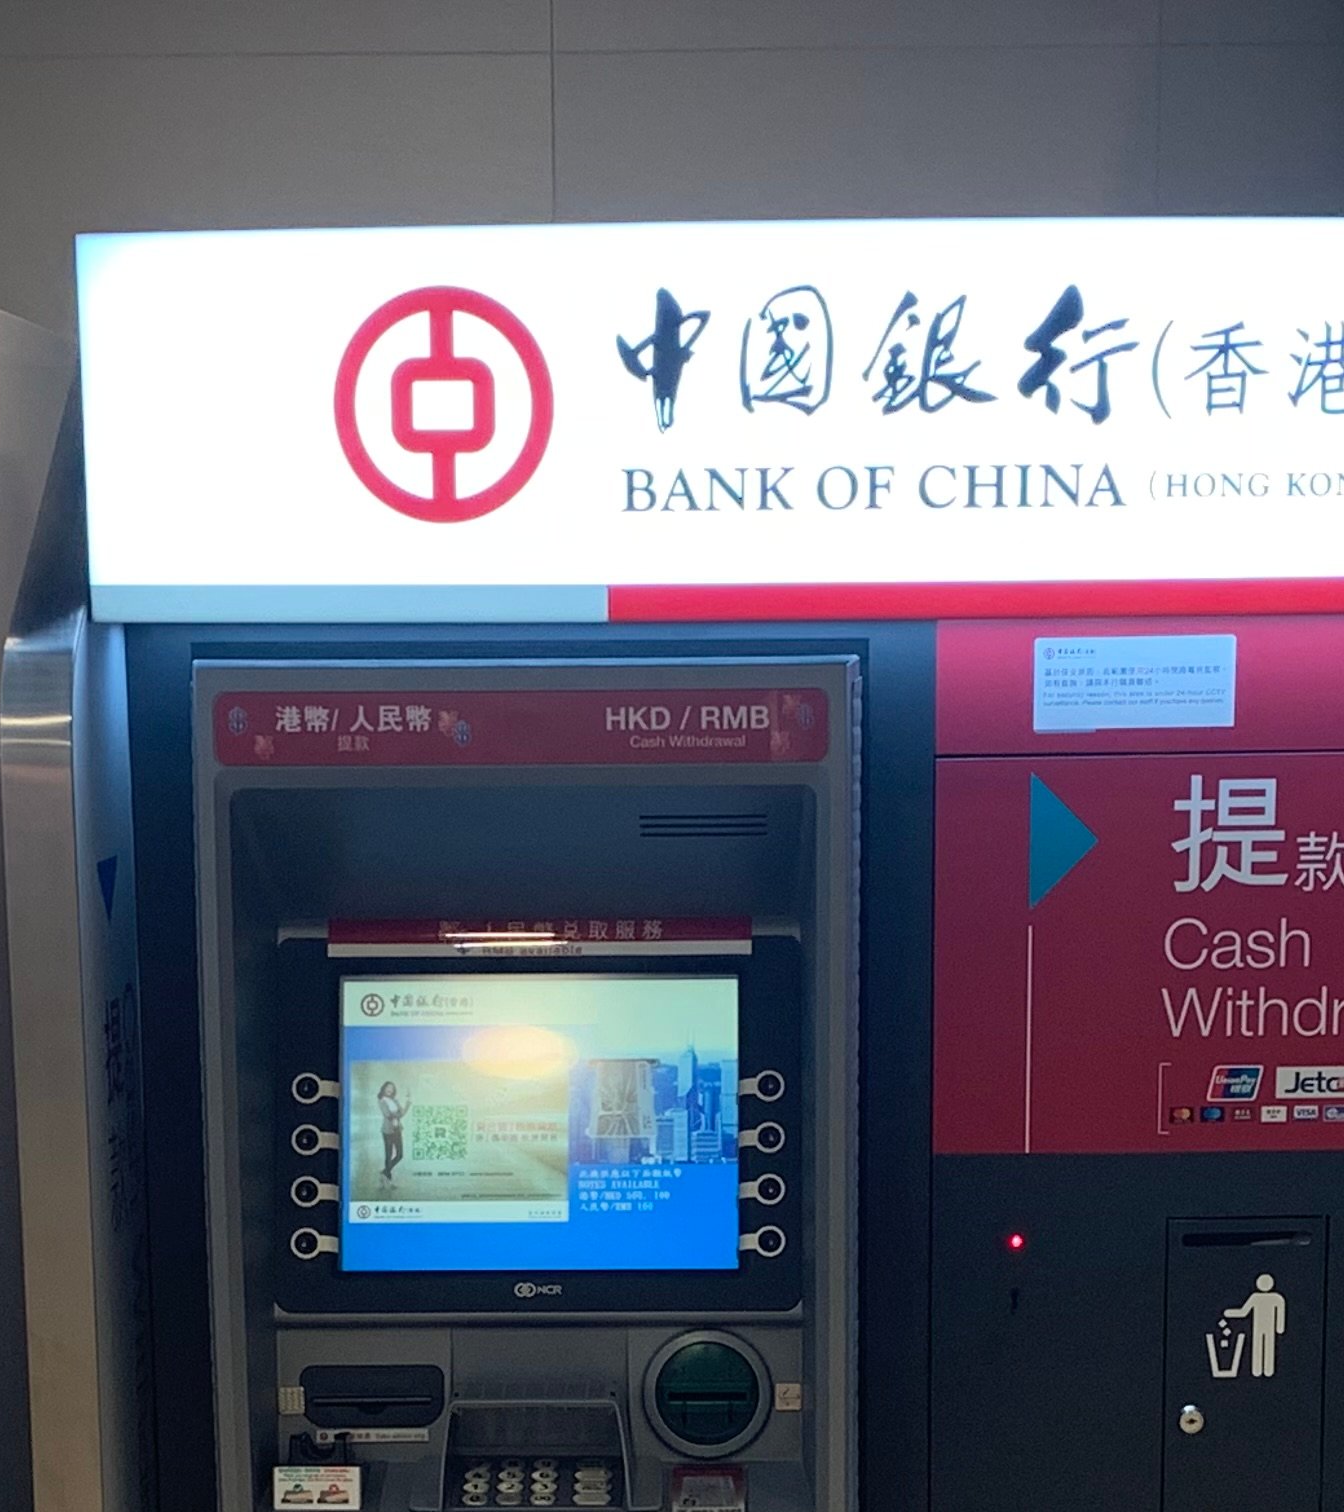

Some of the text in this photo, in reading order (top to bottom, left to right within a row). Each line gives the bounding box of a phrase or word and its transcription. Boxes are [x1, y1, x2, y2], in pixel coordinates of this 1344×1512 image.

[621, 466, 795, 512] BANK
[816, 464, 895, 511] OF
[918, 463, 1127, 510] CHINA
[1150, 469, 1270, 500] (HONG
[349, 705, 432, 733] 人民幣
[605, 705, 770, 731] HKD / RMB
[337, 734, 370, 752] 提款
[630, 734, 746, 749] Cash Withdrawal
[1164, 917, 1311, 970] Cash
[1296, 1109, 1316, 1117] VISA
[536, 1284, 563, 1296] NCR
